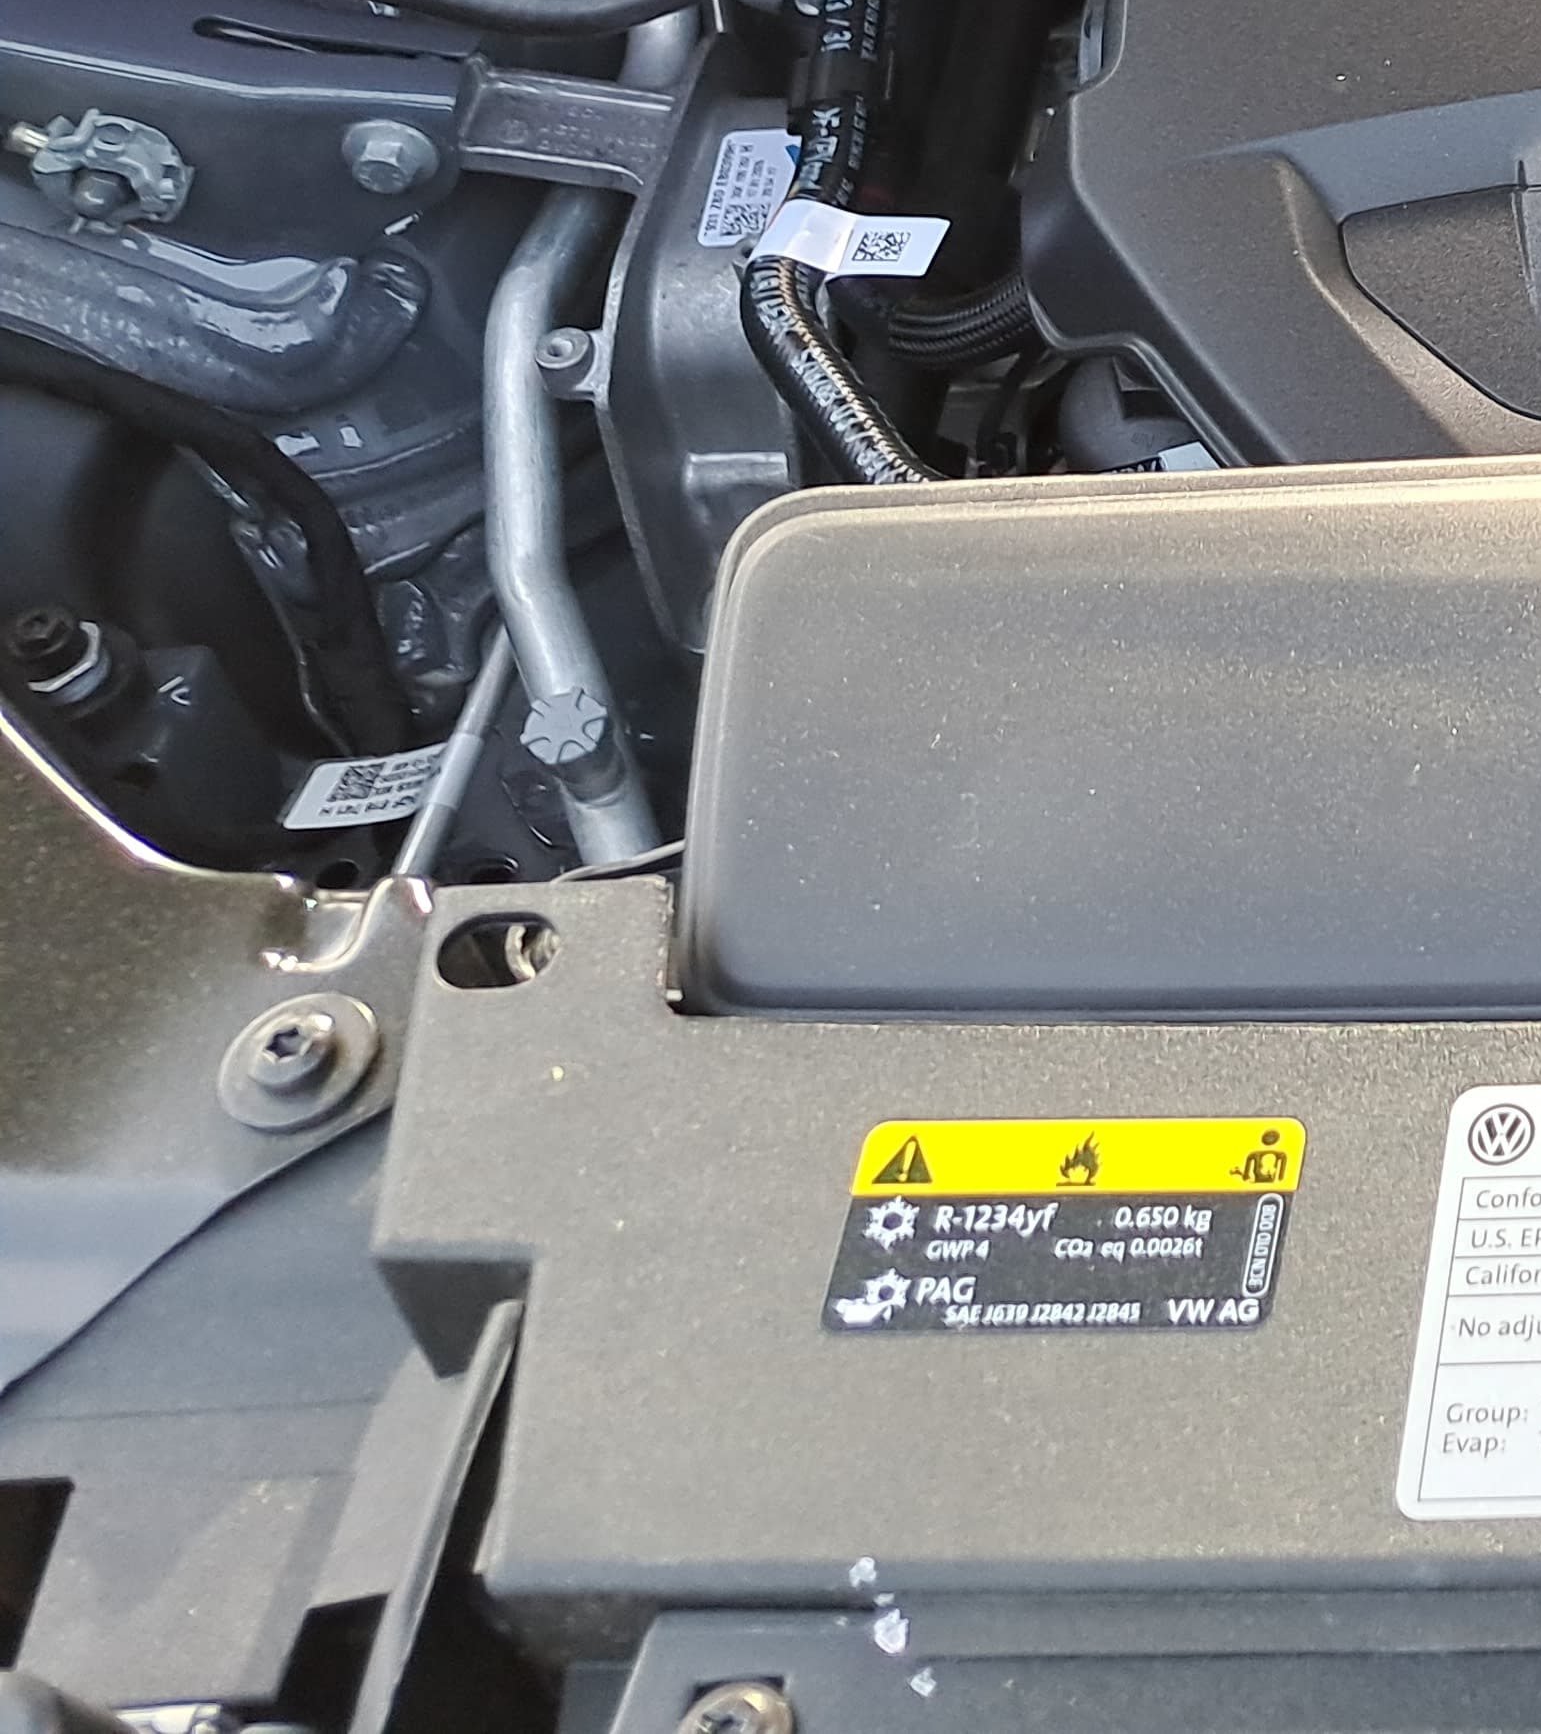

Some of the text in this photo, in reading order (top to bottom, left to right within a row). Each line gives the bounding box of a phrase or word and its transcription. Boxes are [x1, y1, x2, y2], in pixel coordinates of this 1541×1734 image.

[932, 1202, 1214, 1237] R-1234yf 0.650 kg
[925, 1239, 973, 1261] GWP
[975, 1239, 991, 1260] 4
[1100, 1241, 1126, 1265] eq
[1130, 1237, 1205, 1259] 0.0026t
[1471, 1228, 1512, 1249] U.S.
[914, 1277, 978, 1304] PAG
[944, 1303, 982, 1326] SAE
[1168, 1298, 1262, 1326] VW AG
[1458, 1317, 1491, 1338] No
[1445, 1402, 1529, 1428] Group:
[1442, 1432, 1507, 1458] Evap:
